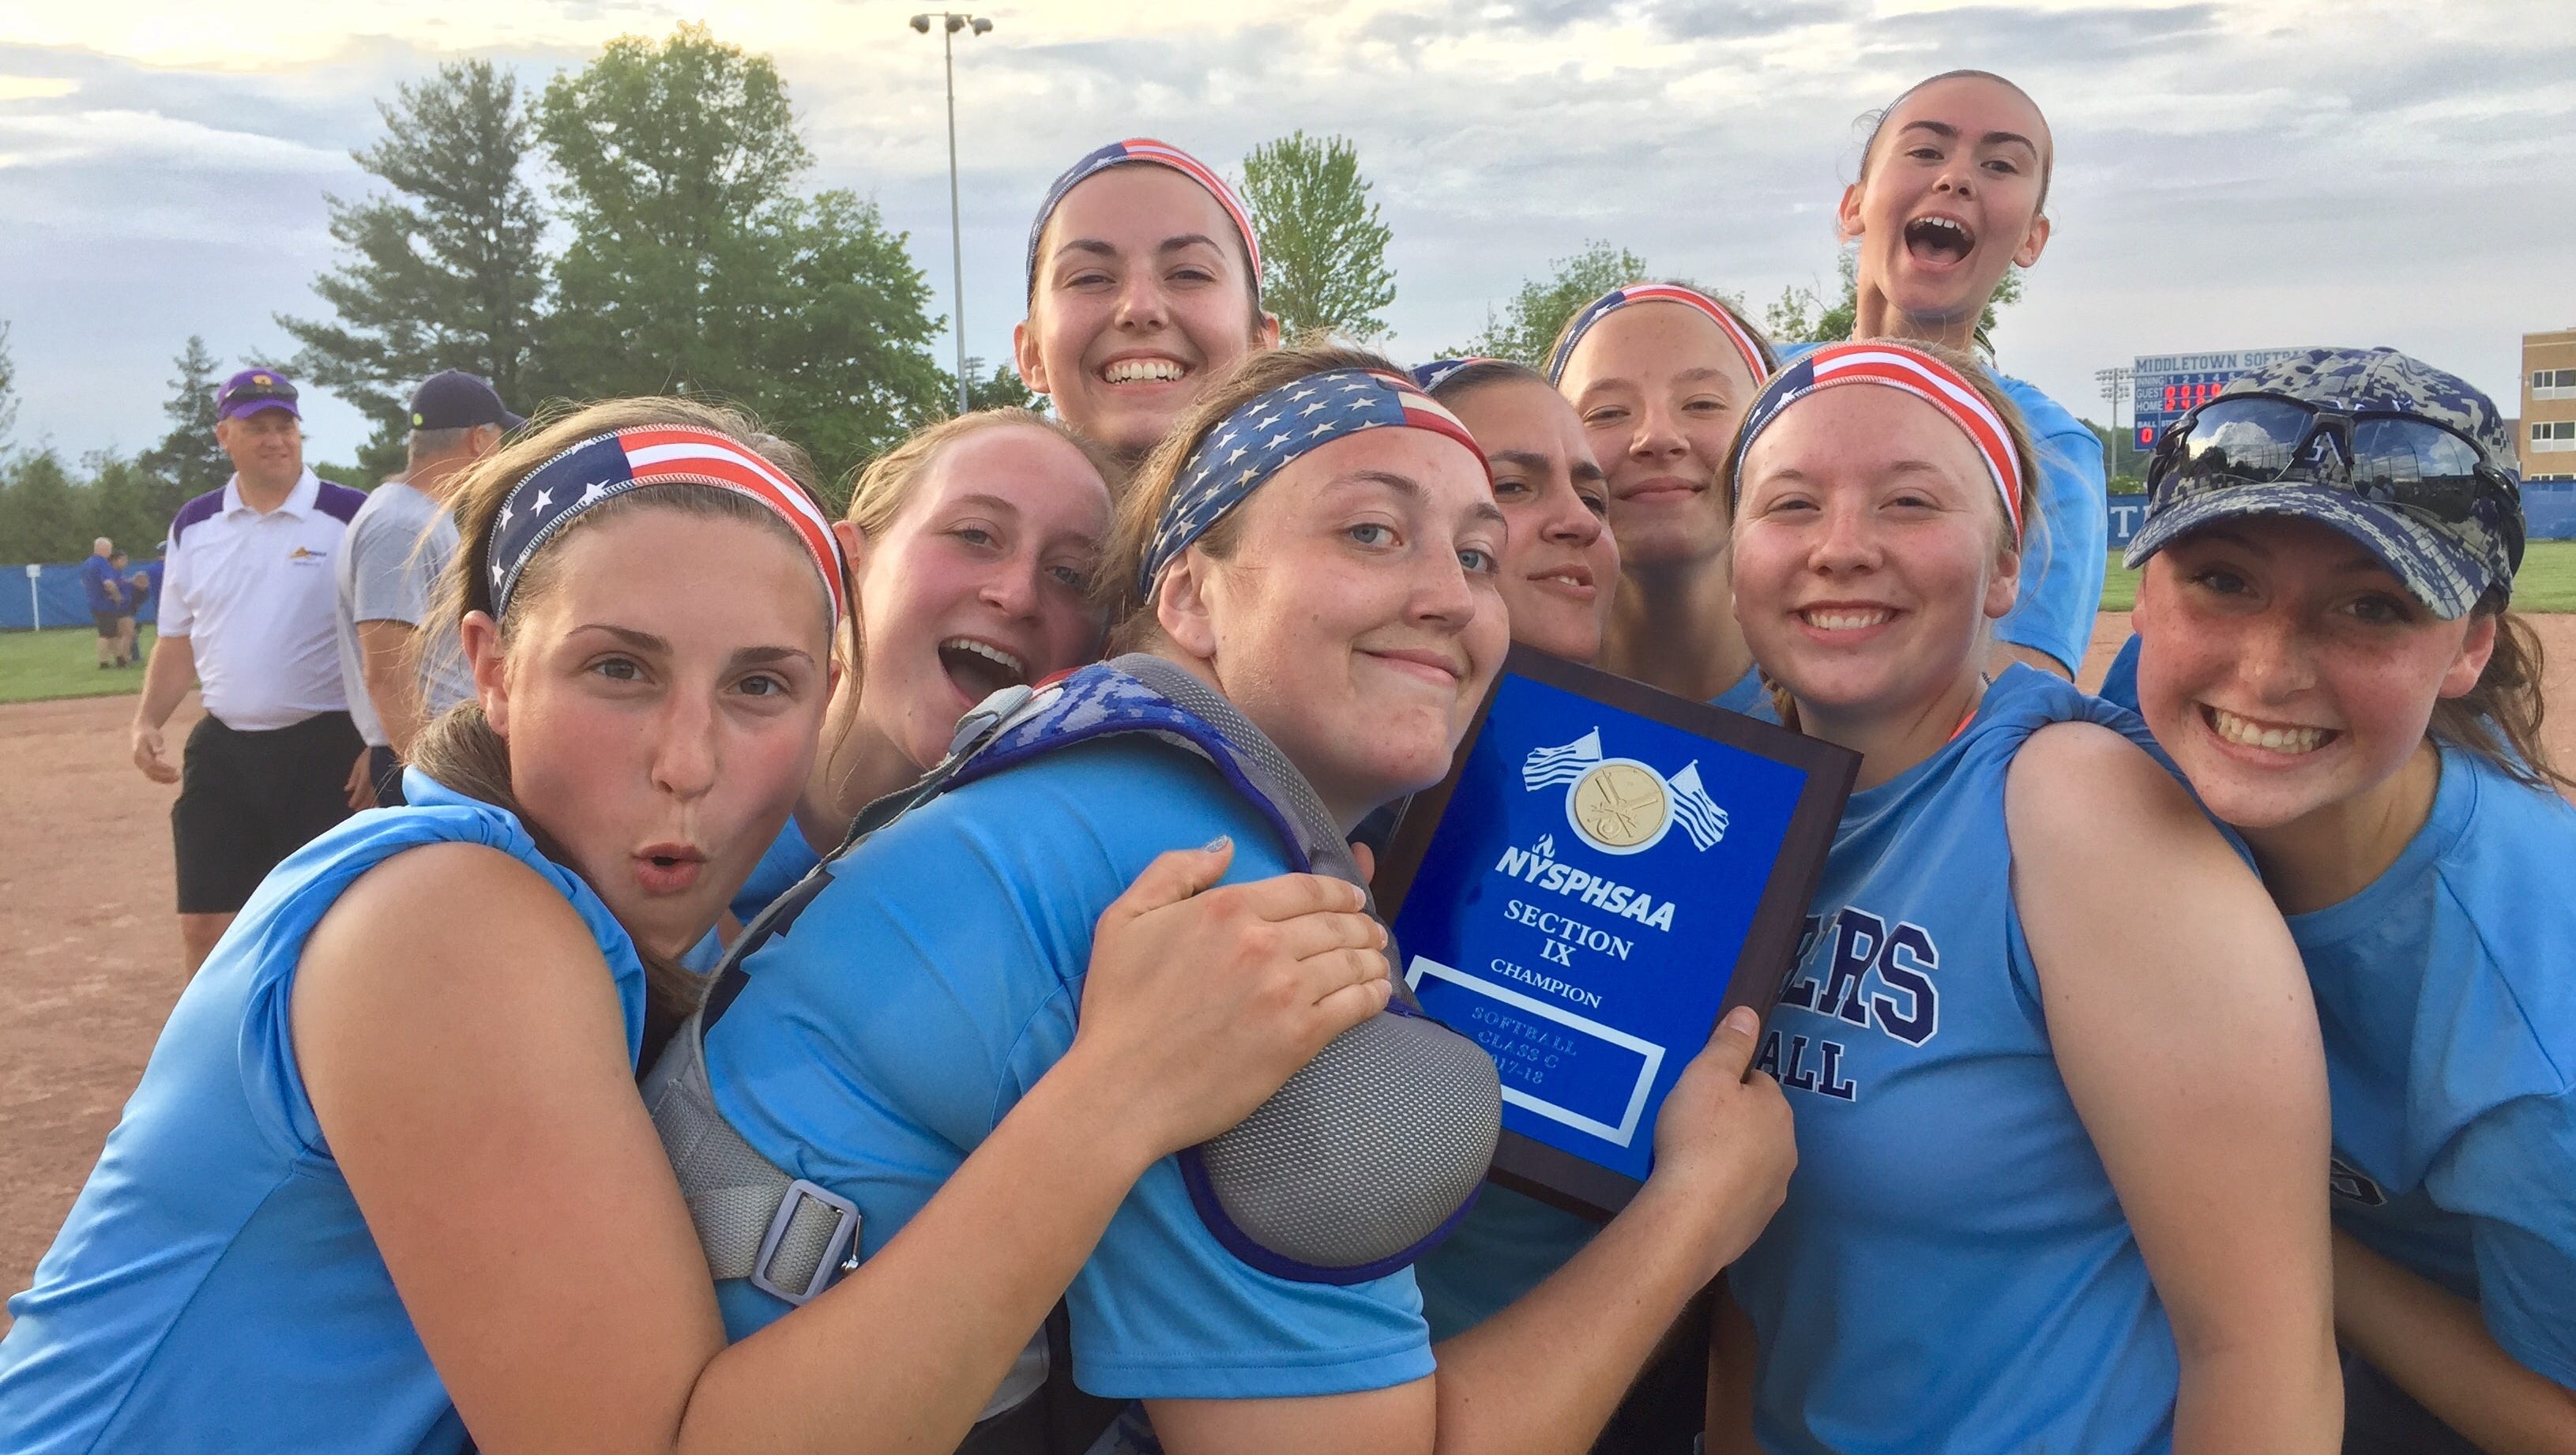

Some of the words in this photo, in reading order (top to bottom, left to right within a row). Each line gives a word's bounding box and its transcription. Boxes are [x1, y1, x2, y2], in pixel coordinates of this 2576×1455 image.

[2136, 354, 2237, 373] MIDDLETOWN
[2136, 376, 2164, 386] INNING
[2183, 374, 2190, 384] 2
[2198, 374, 2205, 383] 3
[2213, 373, 2220, 382] 4
[2136, 387, 2164, 399] GUEST
[2136, 400, 2164, 412] HOME
[2137, 420, 2157, 429] BALL
[2141, 427, 2153, 444] 0
[1495, 845, 1675, 932] NYSPHSAA
[1503, 899, 1634, 961] SECTION
[1540, 938, 1577, 967] IX
[1491, 958, 1603, 1009] CHAMPION
[1472, 1006, 1578, 1057] SOFTBALL
[1478, 1030, 1540, 1062] CLASS
[1544, 1054, 1559, 1069] C
